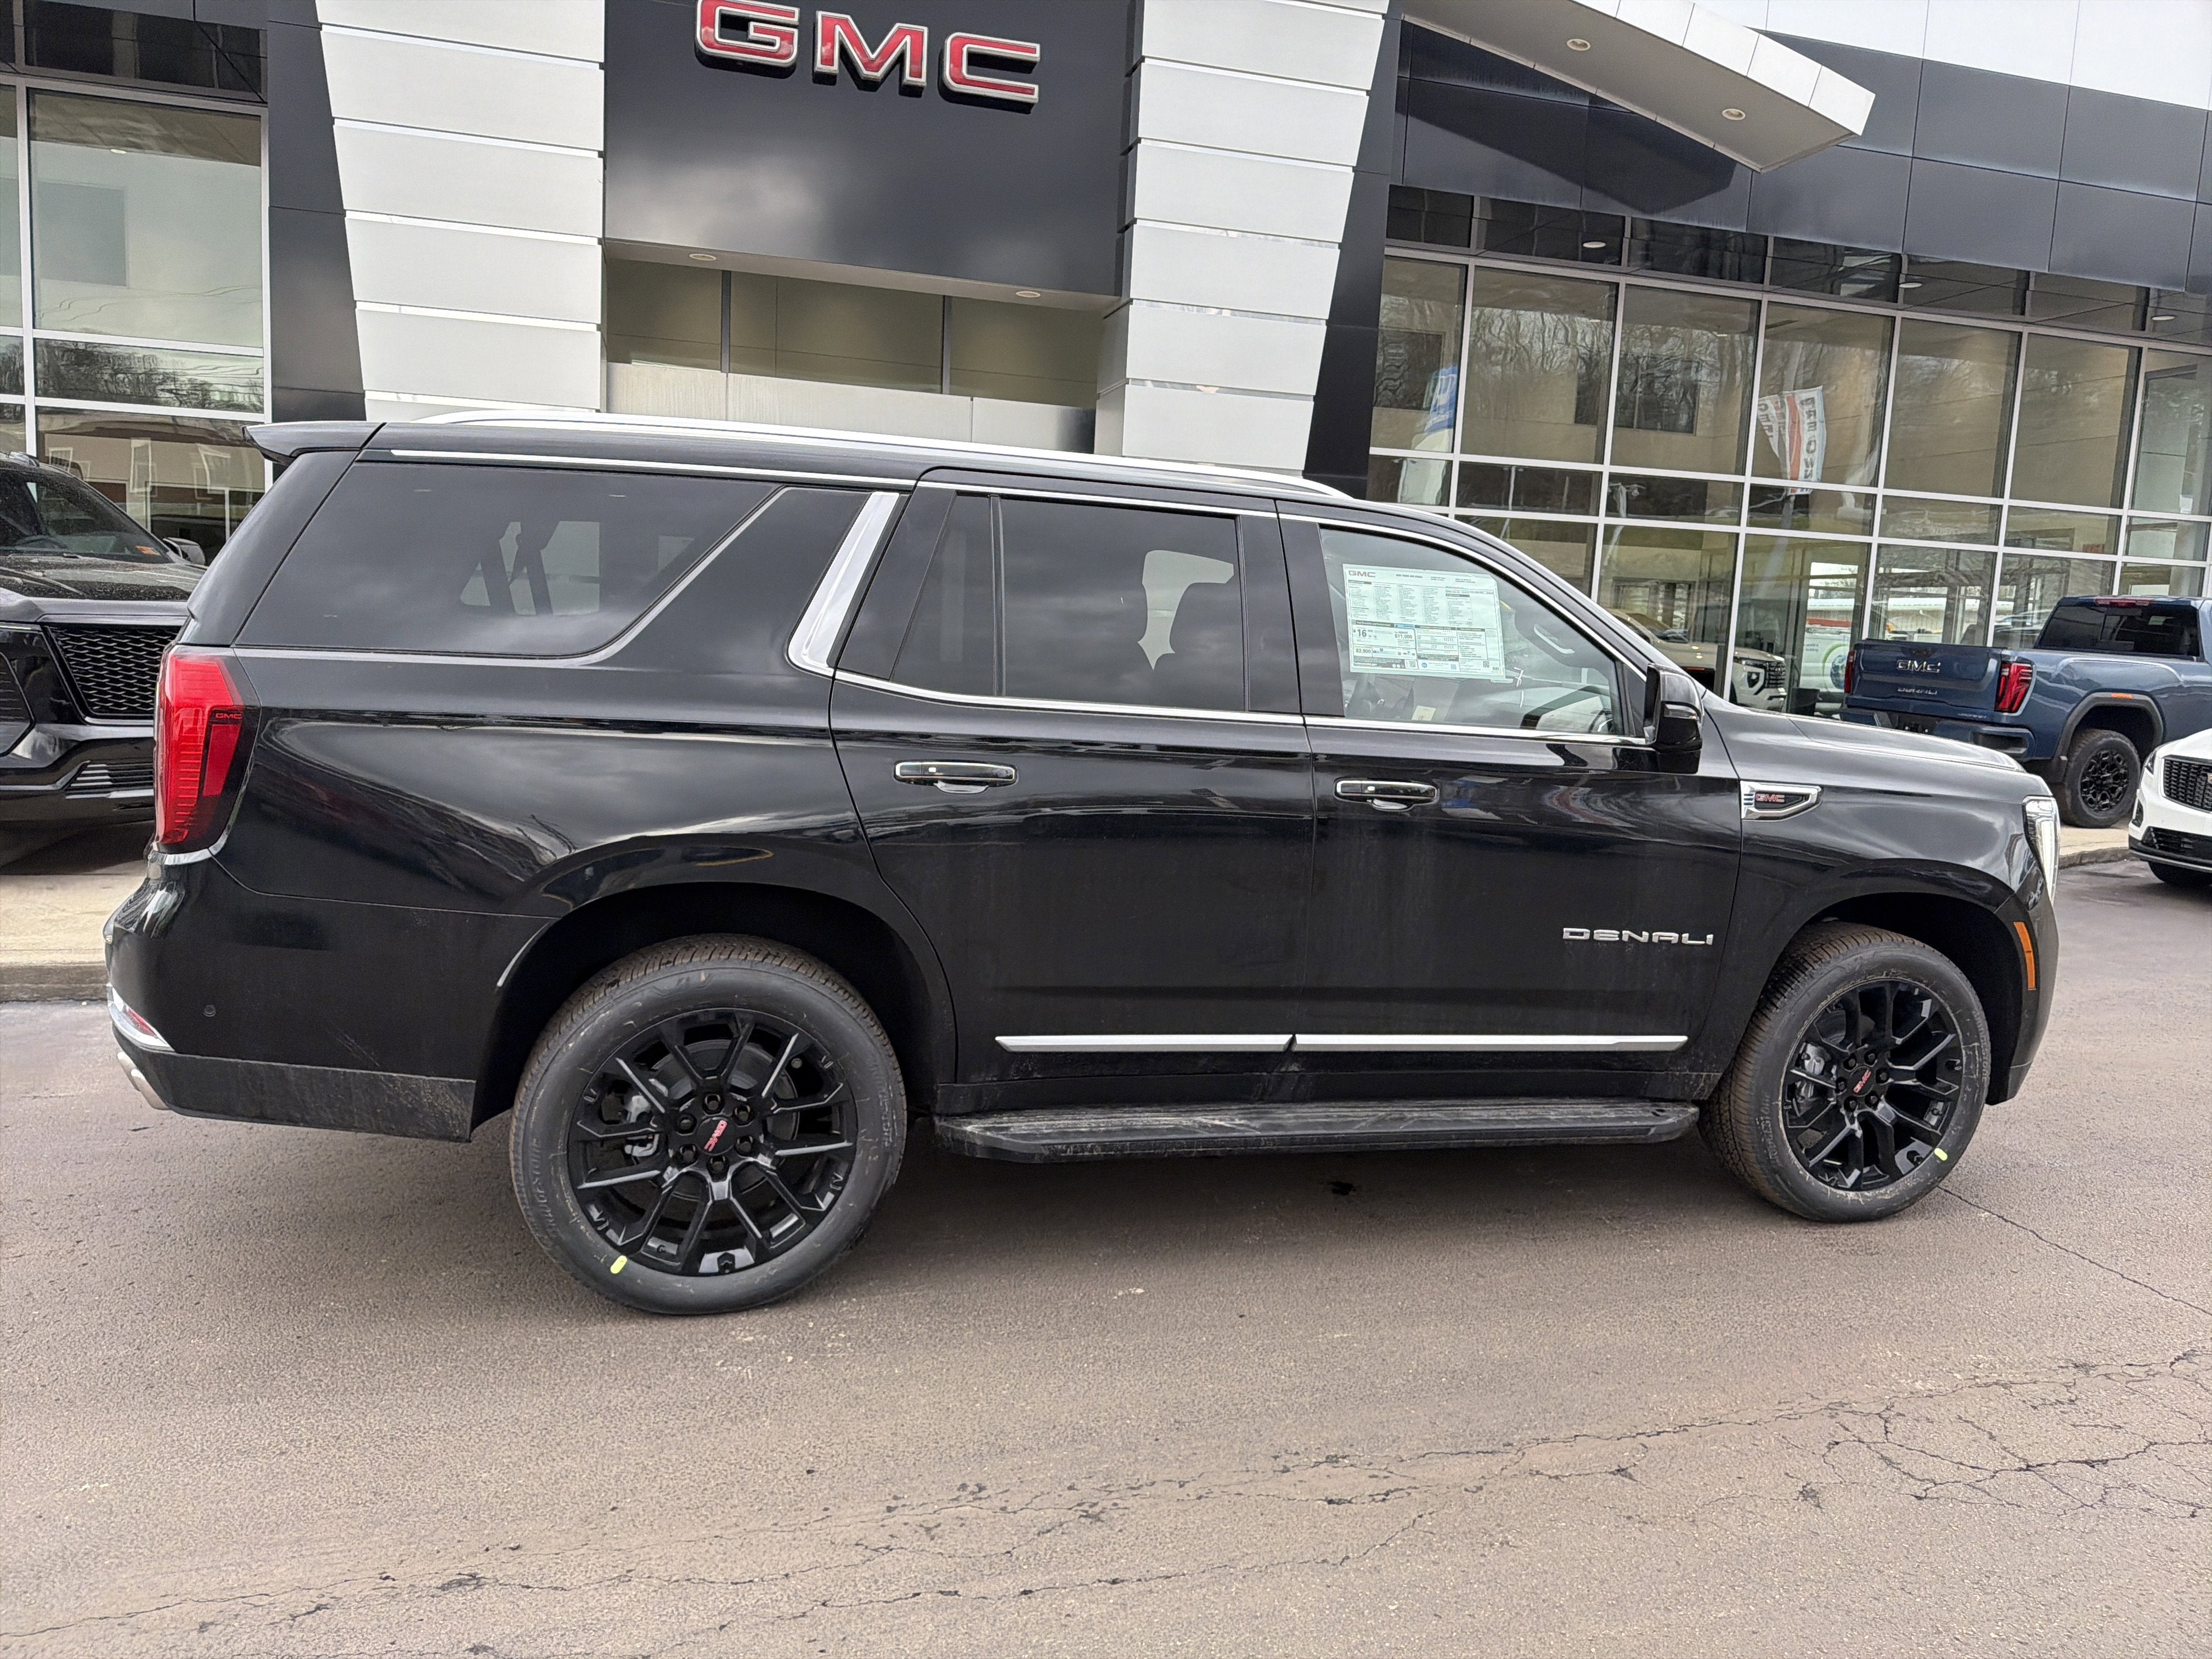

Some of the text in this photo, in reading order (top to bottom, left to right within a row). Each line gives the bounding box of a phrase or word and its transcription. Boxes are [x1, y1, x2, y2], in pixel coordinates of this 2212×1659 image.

[695, 0, 1040, 103] GMC
[1357, 629, 1367, 637] 16
[1897, 659, 1941, 674] GMC
[1756, 793, 1785, 803] GMC
[1562, 927, 1714, 945] DENALI
[1853, 1069, 1871, 1093] GMC
[704, 1120, 728, 1152] GMC
